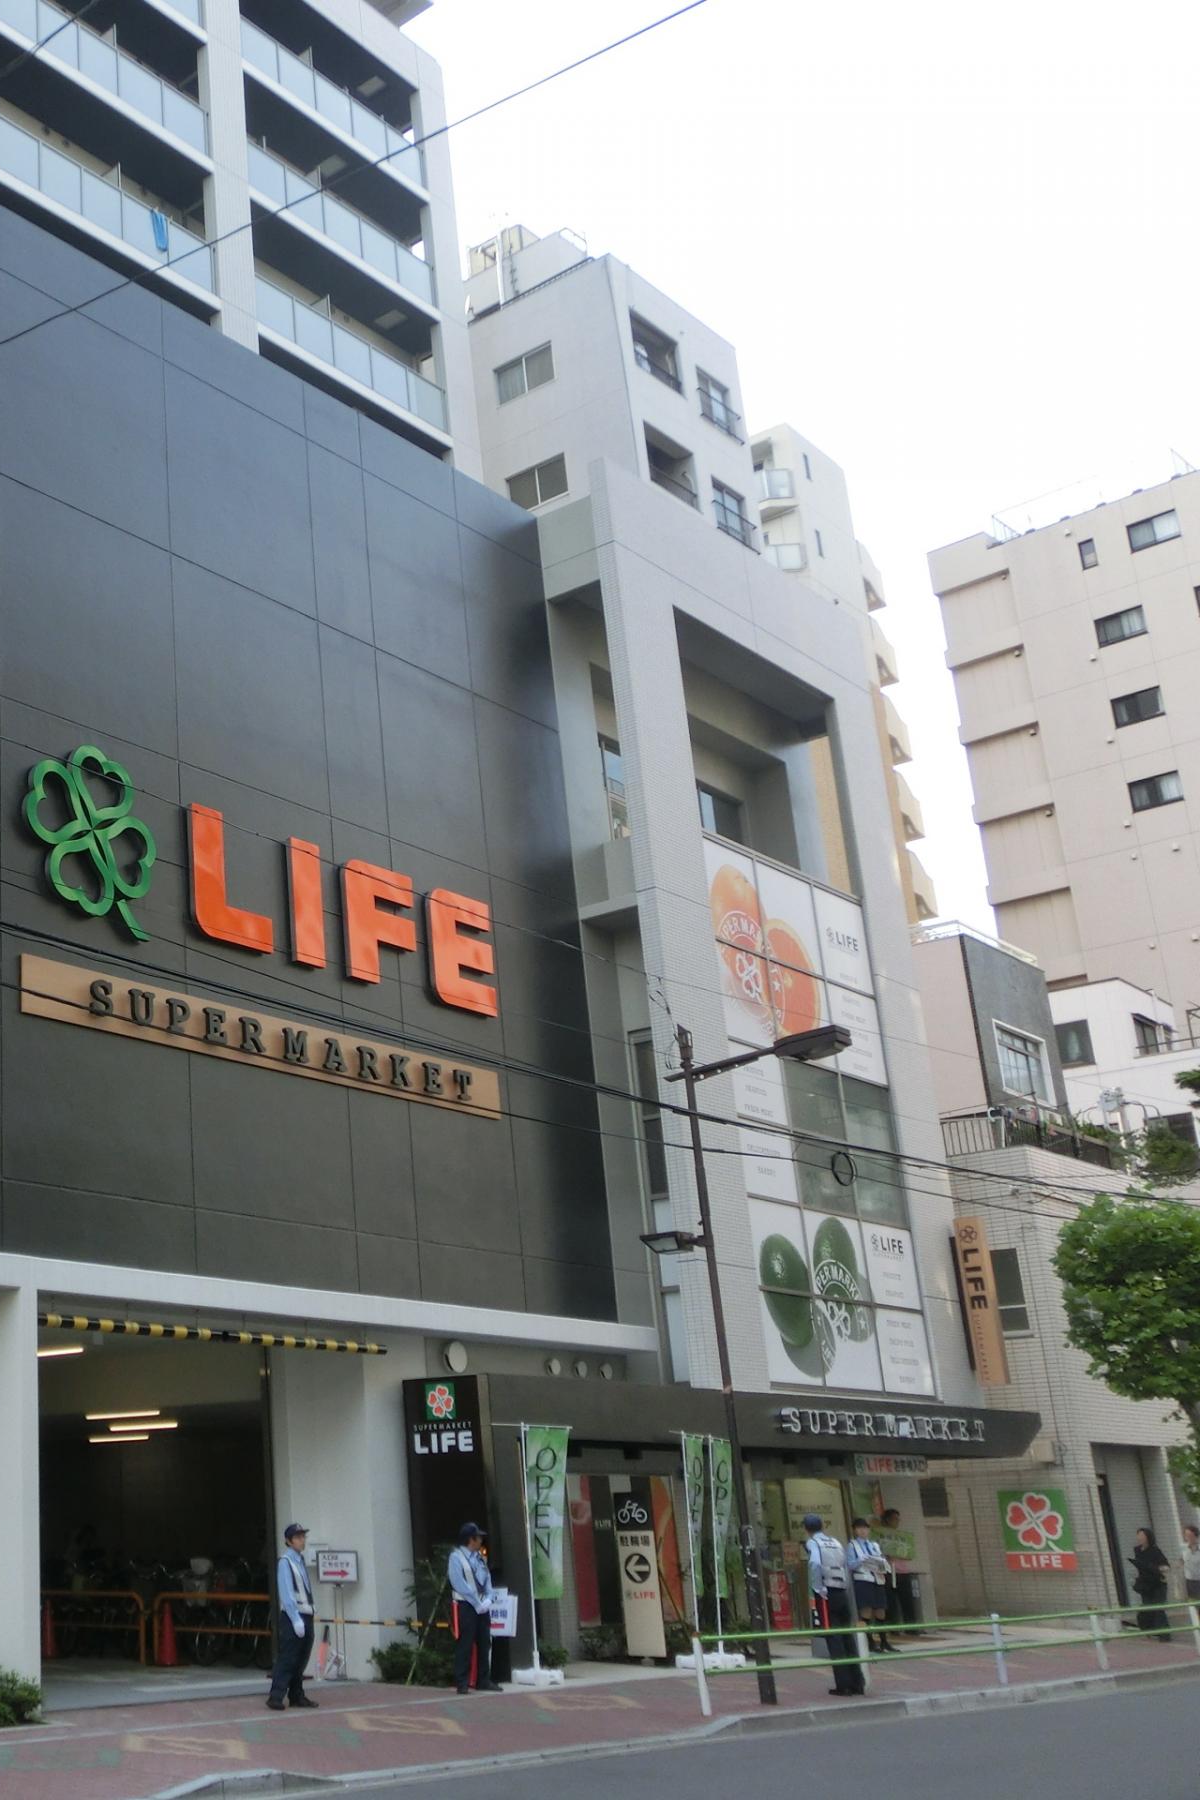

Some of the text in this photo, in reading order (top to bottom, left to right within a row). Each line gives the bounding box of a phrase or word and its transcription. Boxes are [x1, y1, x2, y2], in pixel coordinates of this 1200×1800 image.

[188, 802, 498, 1018] LIFE
[835, 931, 859, 951] LIFE
[89, 979, 473, 1101] SUPERMARKET
[879, 1236, 904, 1254] LIFE
[962, 1248, 989, 1310] LIFE
[413, 1421, 472, 1431] SUPERMARKET
[781, 1408, 985, 1441] SUPERMARKET
[414, 1430, 474, 1454] LIFE
[866, 1457, 894, 1473] LIFE
[535, 1446, 557, 1560] OPEN
[1020, 1555, 1062, 1568] LIFE
[633, 1591, 656, 1600] LIFE
